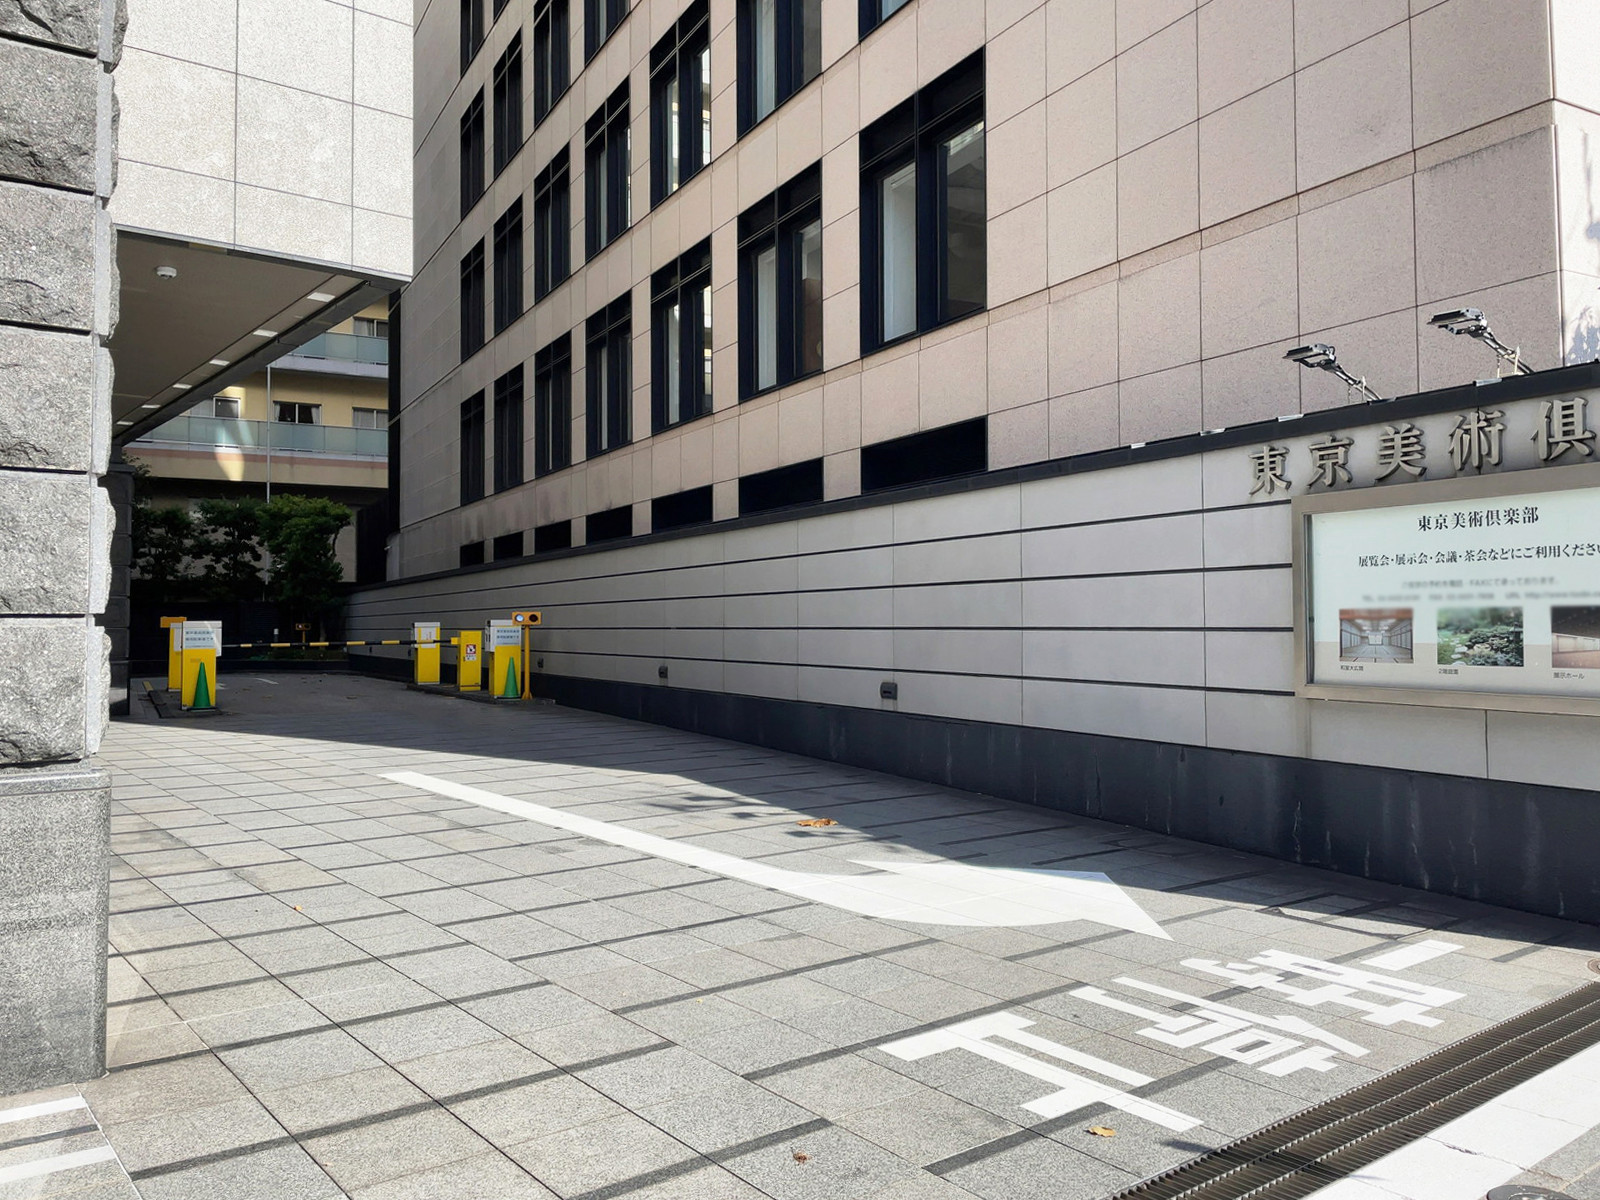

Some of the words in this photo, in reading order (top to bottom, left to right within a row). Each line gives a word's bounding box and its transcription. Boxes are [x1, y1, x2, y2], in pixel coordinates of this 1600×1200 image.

[1248, 396, 1597, 496] 東京美術倶
[1417, 506, 1540, 532] 東京美術倶楽部
